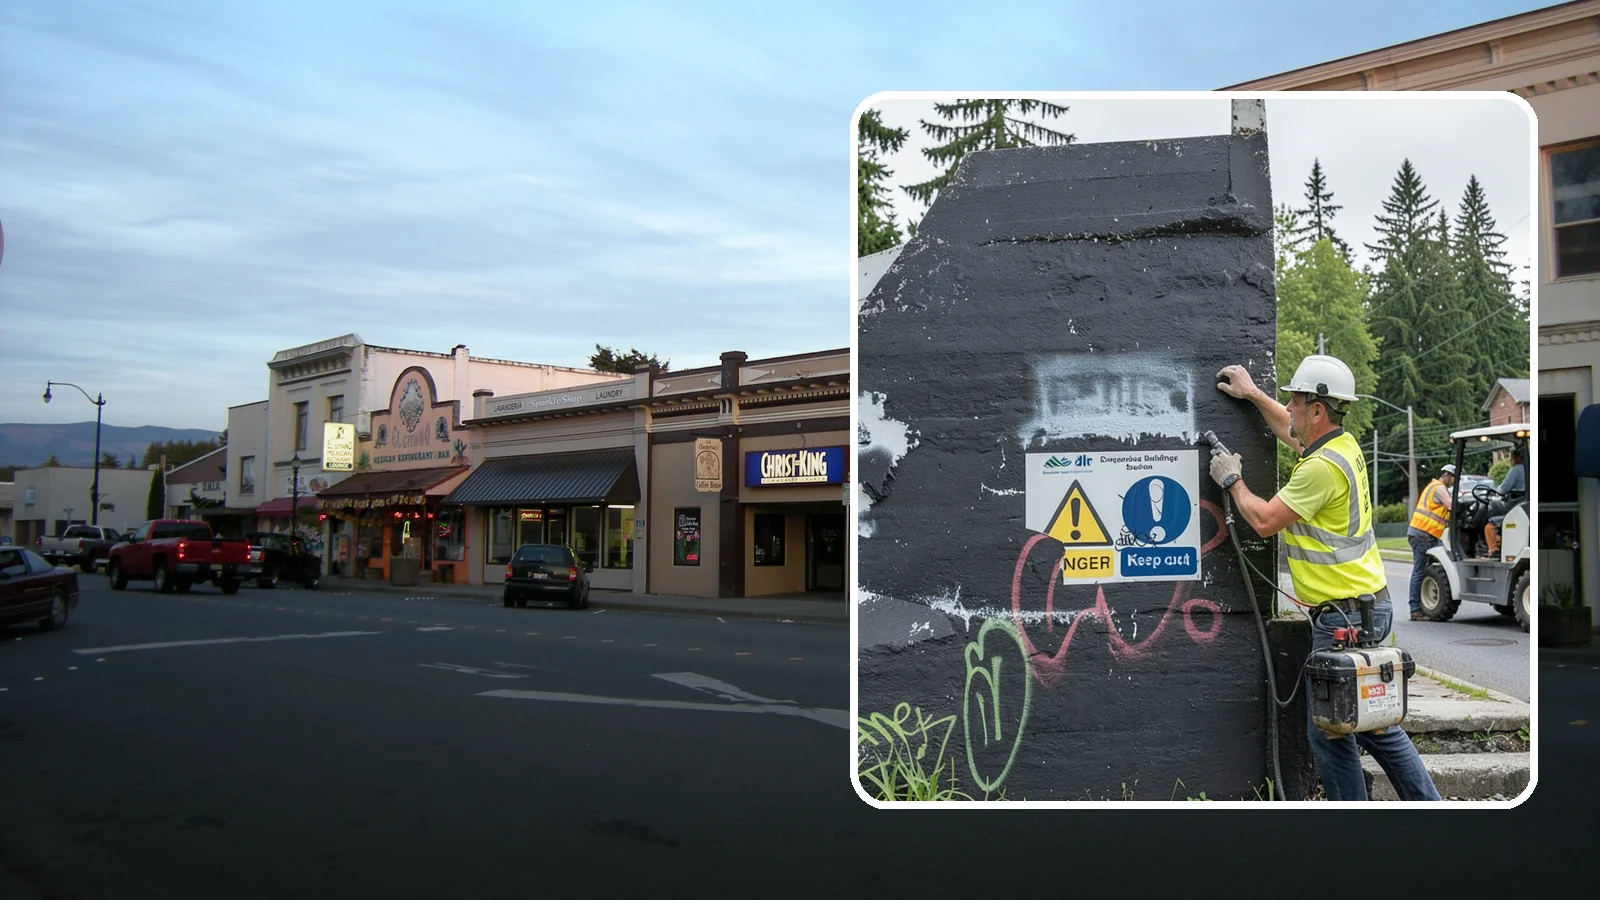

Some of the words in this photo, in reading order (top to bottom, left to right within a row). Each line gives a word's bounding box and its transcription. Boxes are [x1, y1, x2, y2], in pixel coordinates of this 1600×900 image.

[530, 396, 559, 408] Sparkle
[562, 394, 582, 404] Shop
[595, 389, 623, 399] LAUNDRY
[494, 402, 522, 412] LAVANDERIA
[397, 452, 433, 462] RESTAURANT
[799, 450, 827, 476] KING
[1064, 556, 1110, 570] NGER
[1127, 554, 1161, 569] Keep
